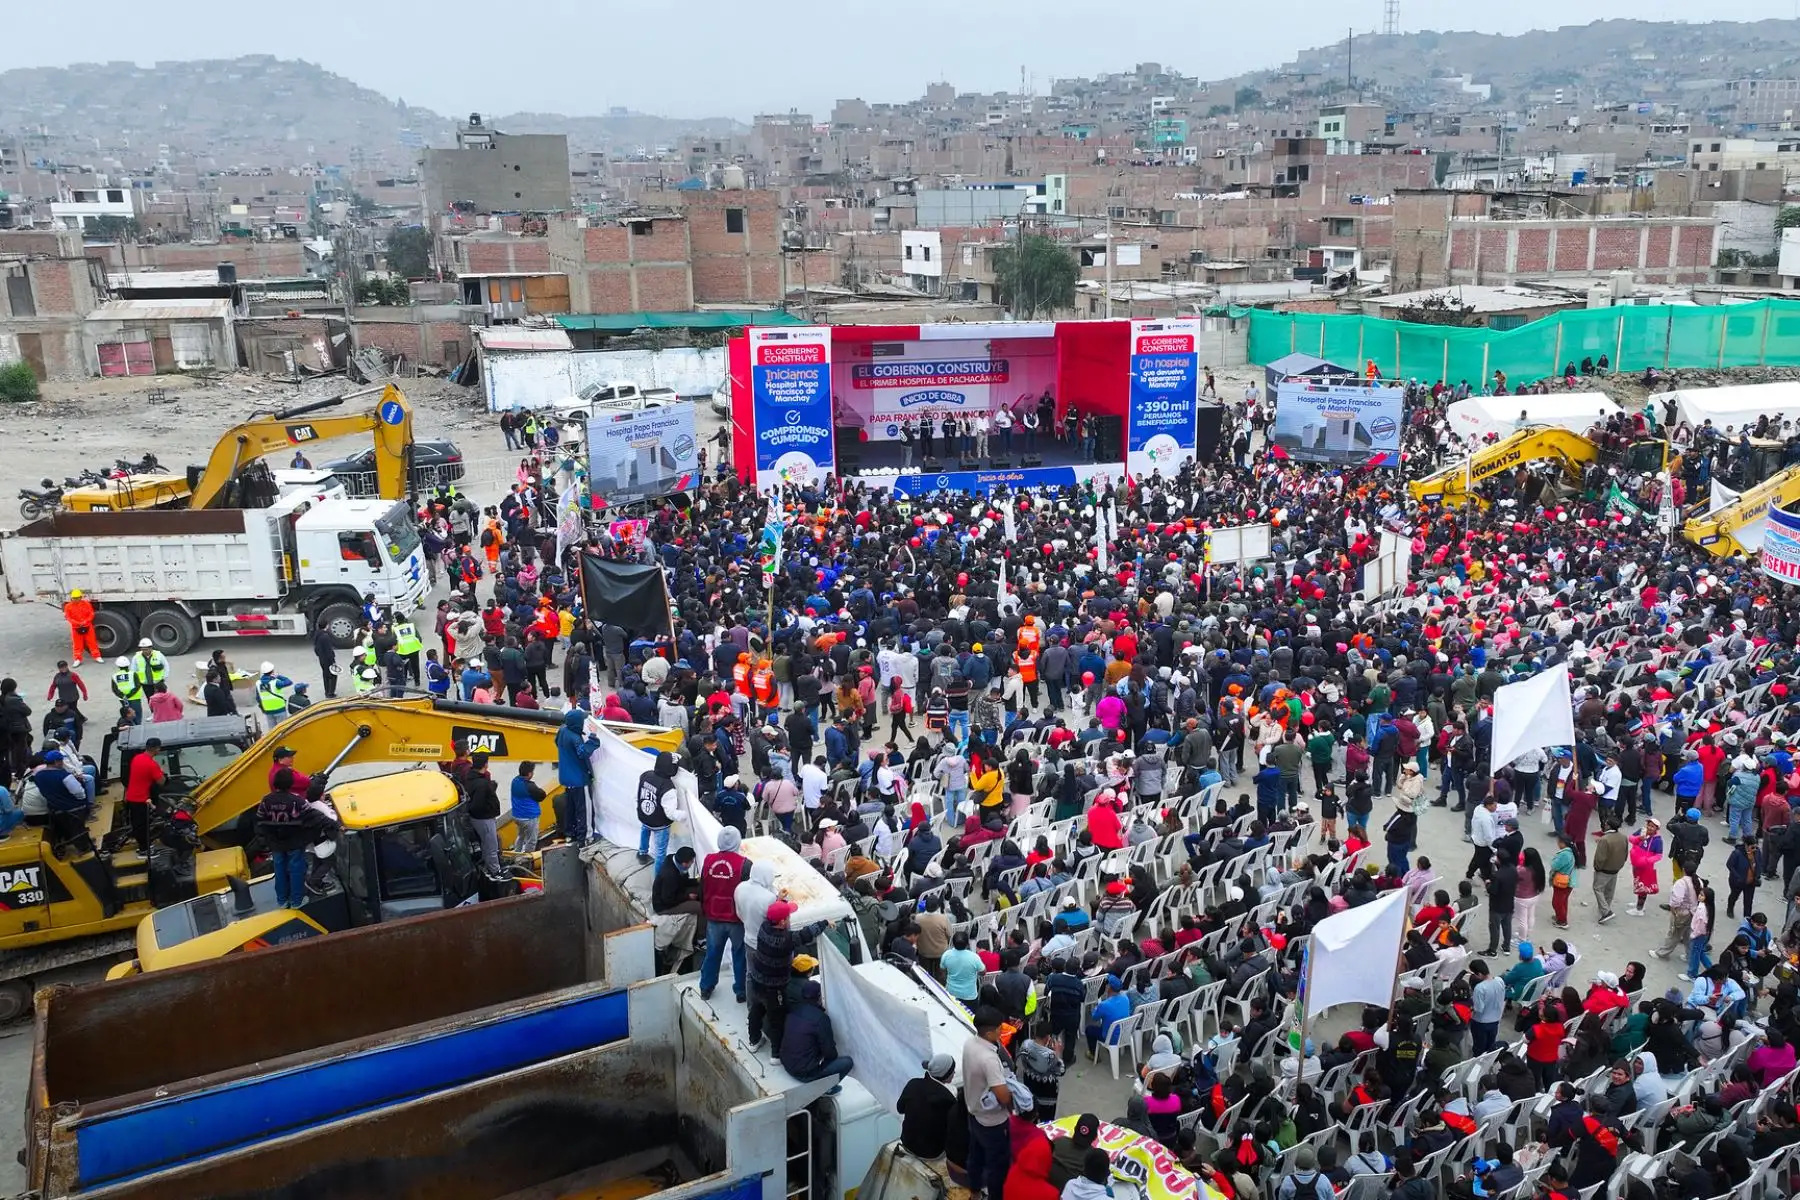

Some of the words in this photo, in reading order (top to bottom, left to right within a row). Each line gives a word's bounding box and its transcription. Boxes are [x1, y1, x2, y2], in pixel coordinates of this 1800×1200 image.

[764, 355, 818, 363] CONSTRUYE
[1155, 357, 1189, 368] hospital
[765, 369, 819, 380] Iniciamos
[859, 367, 870, 376] EL
[873, 363, 934, 376] GOBIERNO
[937, 362, 1003, 374] CONSTRUYE
[765, 381, 797, 389] Hospital
[799, 381, 819, 389] Papa
[870, 379, 897, 387] PRIMER
[900, 377, 936, 385] HOSPITAL
[938, 376, 947, 384] DE
[1149, 381, 1177, 389] Manchay
[775, 395, 810, 403] Manchay
[903, 393, 927, 405] INICIO
[928, 392, 939, 400] DE
[941, 392, 962, 403] OBRA
[1297, 396, 1326, 405] Hospital
[1348, 398, 1381, 407] Francisco
[1171, 400, 1189, 410] mil
[1328, 404, 1360, 413] Manchay
[870, 414, 892, 423] PAPA
[1137, 418, 1188, 426] BENEFICIADOS
[295, 426, 312, 441] CAT
[606, 425, 632, 438] Hospital
[634, 424, 650, 433] Papa
[652, 418, 679, 429] Francisco
[761, 425, 828, 440] COMPROMISO
[625, 434, 634, 442] de
[635, 430, 663, 441] Manchay
[771, 434, 819, 445] CUMPLIDO
[1472, 450, 1521, 478] KOMATSU
[1742, 495, 1782, 521] KOMASU
[467, 734, 499, 752] CAT
[0, 867, 40, 893] CAT
[18, 891, 44, 903] 330
